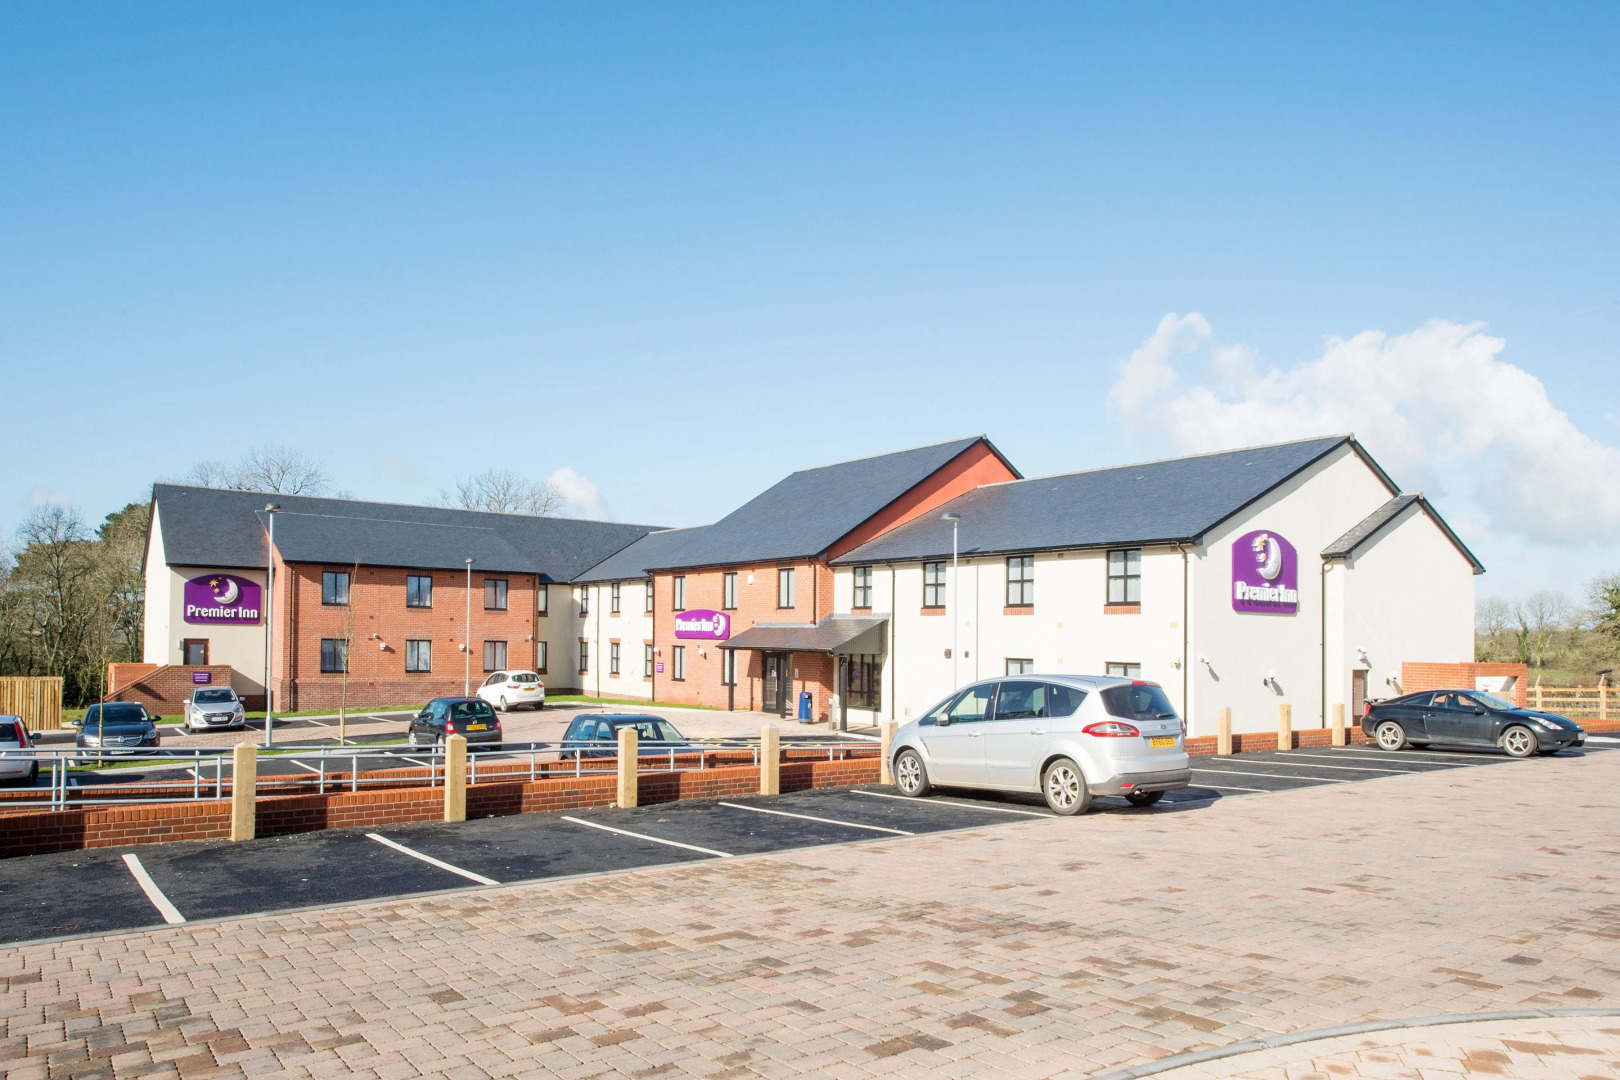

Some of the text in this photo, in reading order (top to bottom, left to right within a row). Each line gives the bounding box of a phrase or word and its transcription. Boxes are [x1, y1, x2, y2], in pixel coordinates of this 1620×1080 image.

[1234, 581, 1297, 603] Premier Inn
[187, 605, 258, 618] Premier Inn
